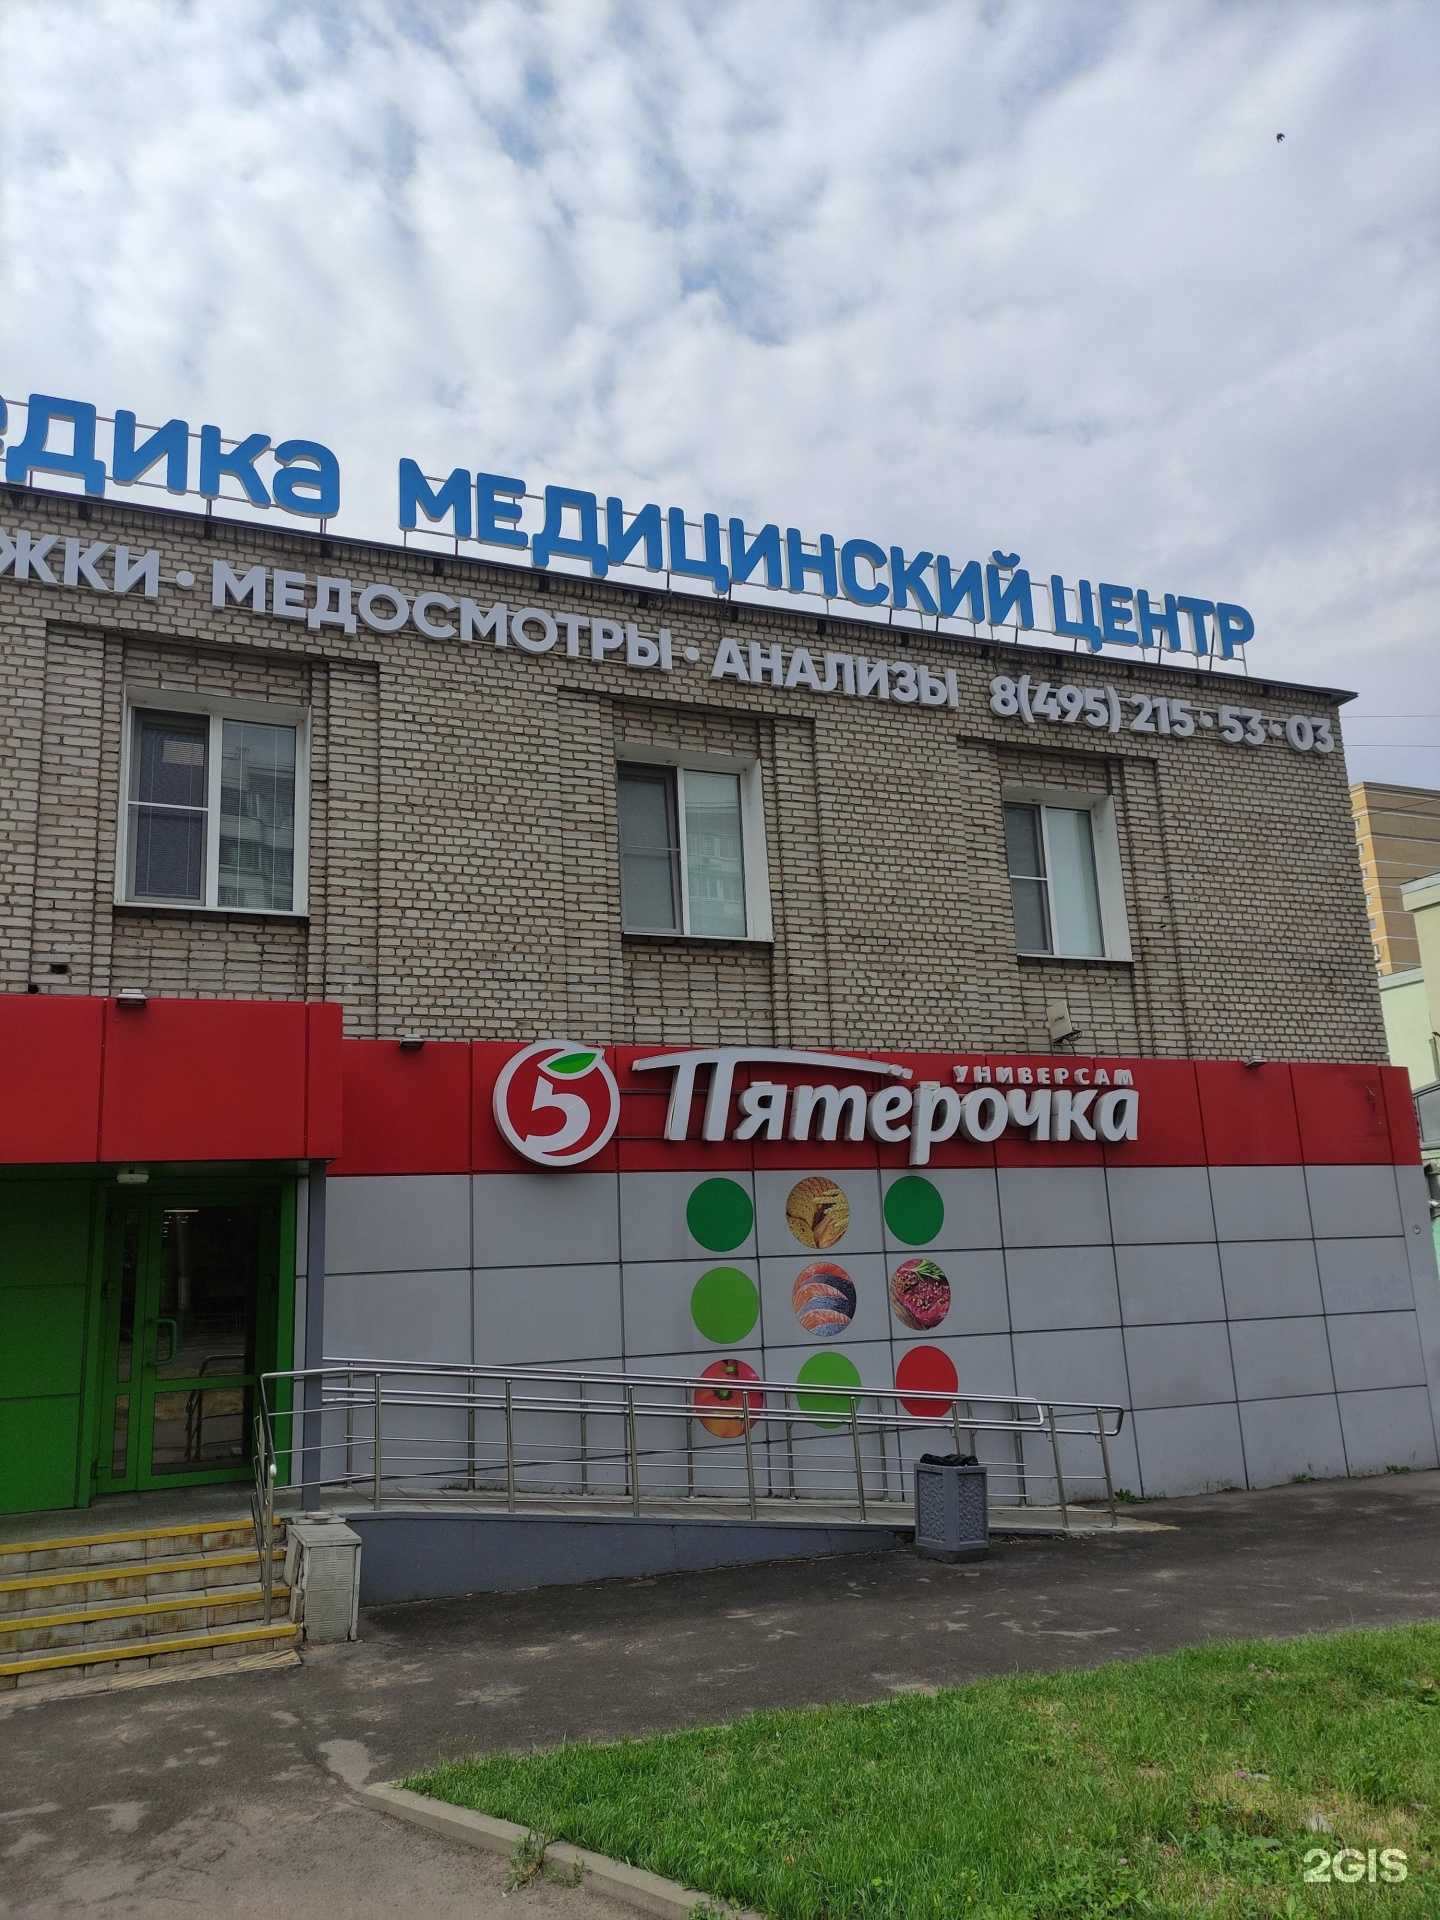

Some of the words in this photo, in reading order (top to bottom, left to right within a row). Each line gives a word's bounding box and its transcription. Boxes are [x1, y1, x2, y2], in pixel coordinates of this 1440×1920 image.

[0, 393, 340, 519] дика
[399, 457, 1034, 632] МЕДИЦИНСКИЙ
[1050, 574, 1255, 660] ЦЕНТР
[0, 528, 161, 598] ЖКИ
[212, 560, 673, 671] МЕДОСМОТРЫ
[711, 638, 959, 709] АНАЛИЗЫ
[632, 1047, 1139, 1167] Пятерочка
[953, 1065, 1134, 1085] УНИВЕРСАМ
